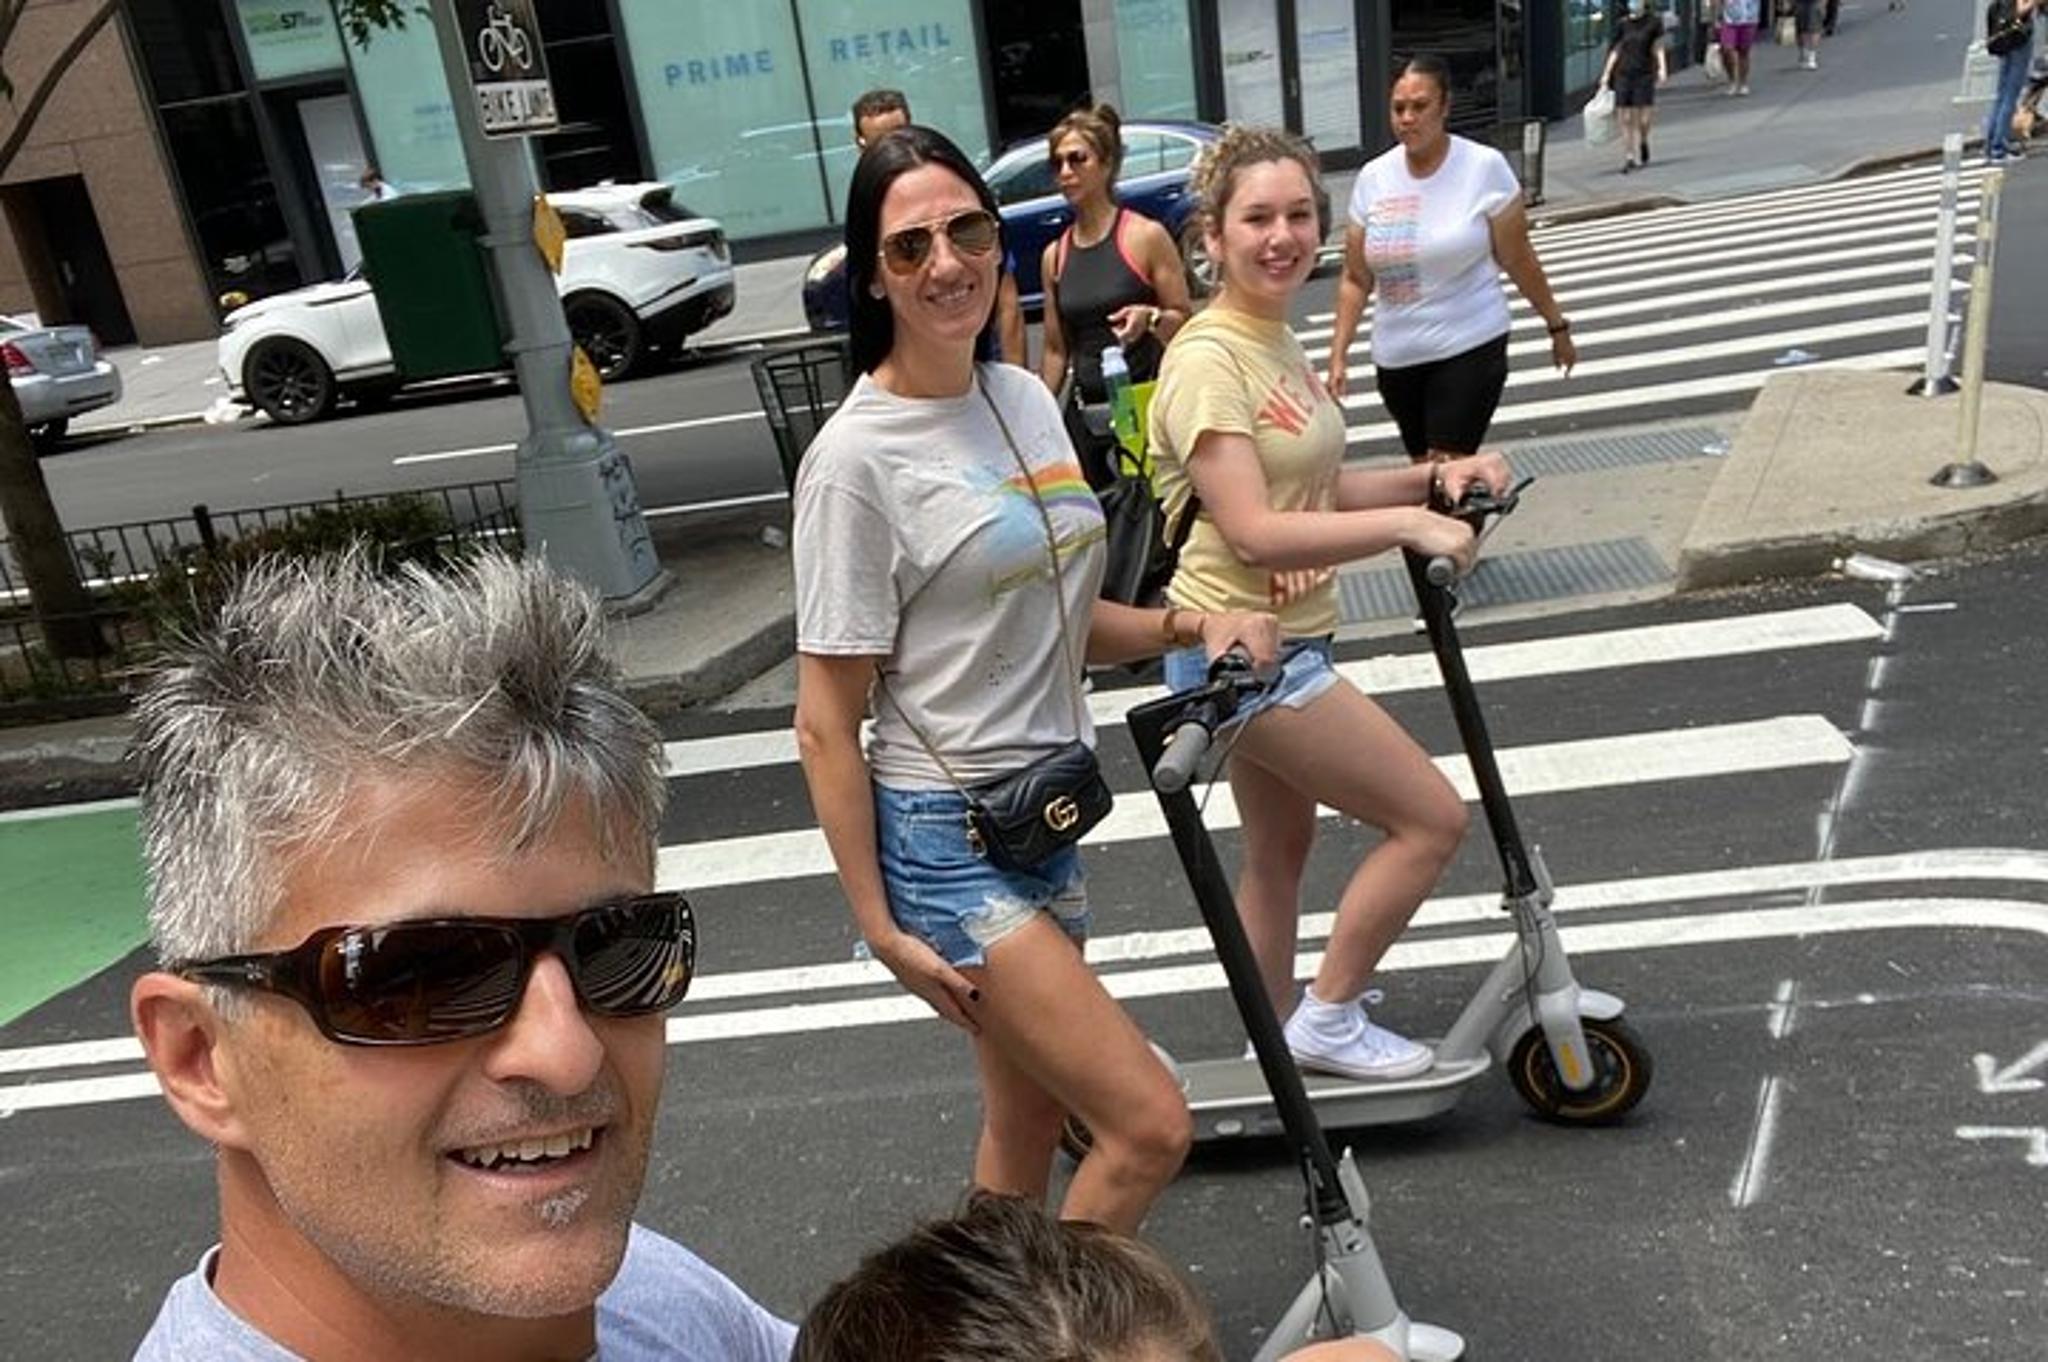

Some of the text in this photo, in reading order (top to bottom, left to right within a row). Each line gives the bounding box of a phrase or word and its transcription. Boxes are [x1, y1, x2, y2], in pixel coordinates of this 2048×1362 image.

[664, 22, 951, 87] PRIME RETAIL
[479, 89, 520, 124] BIKE
